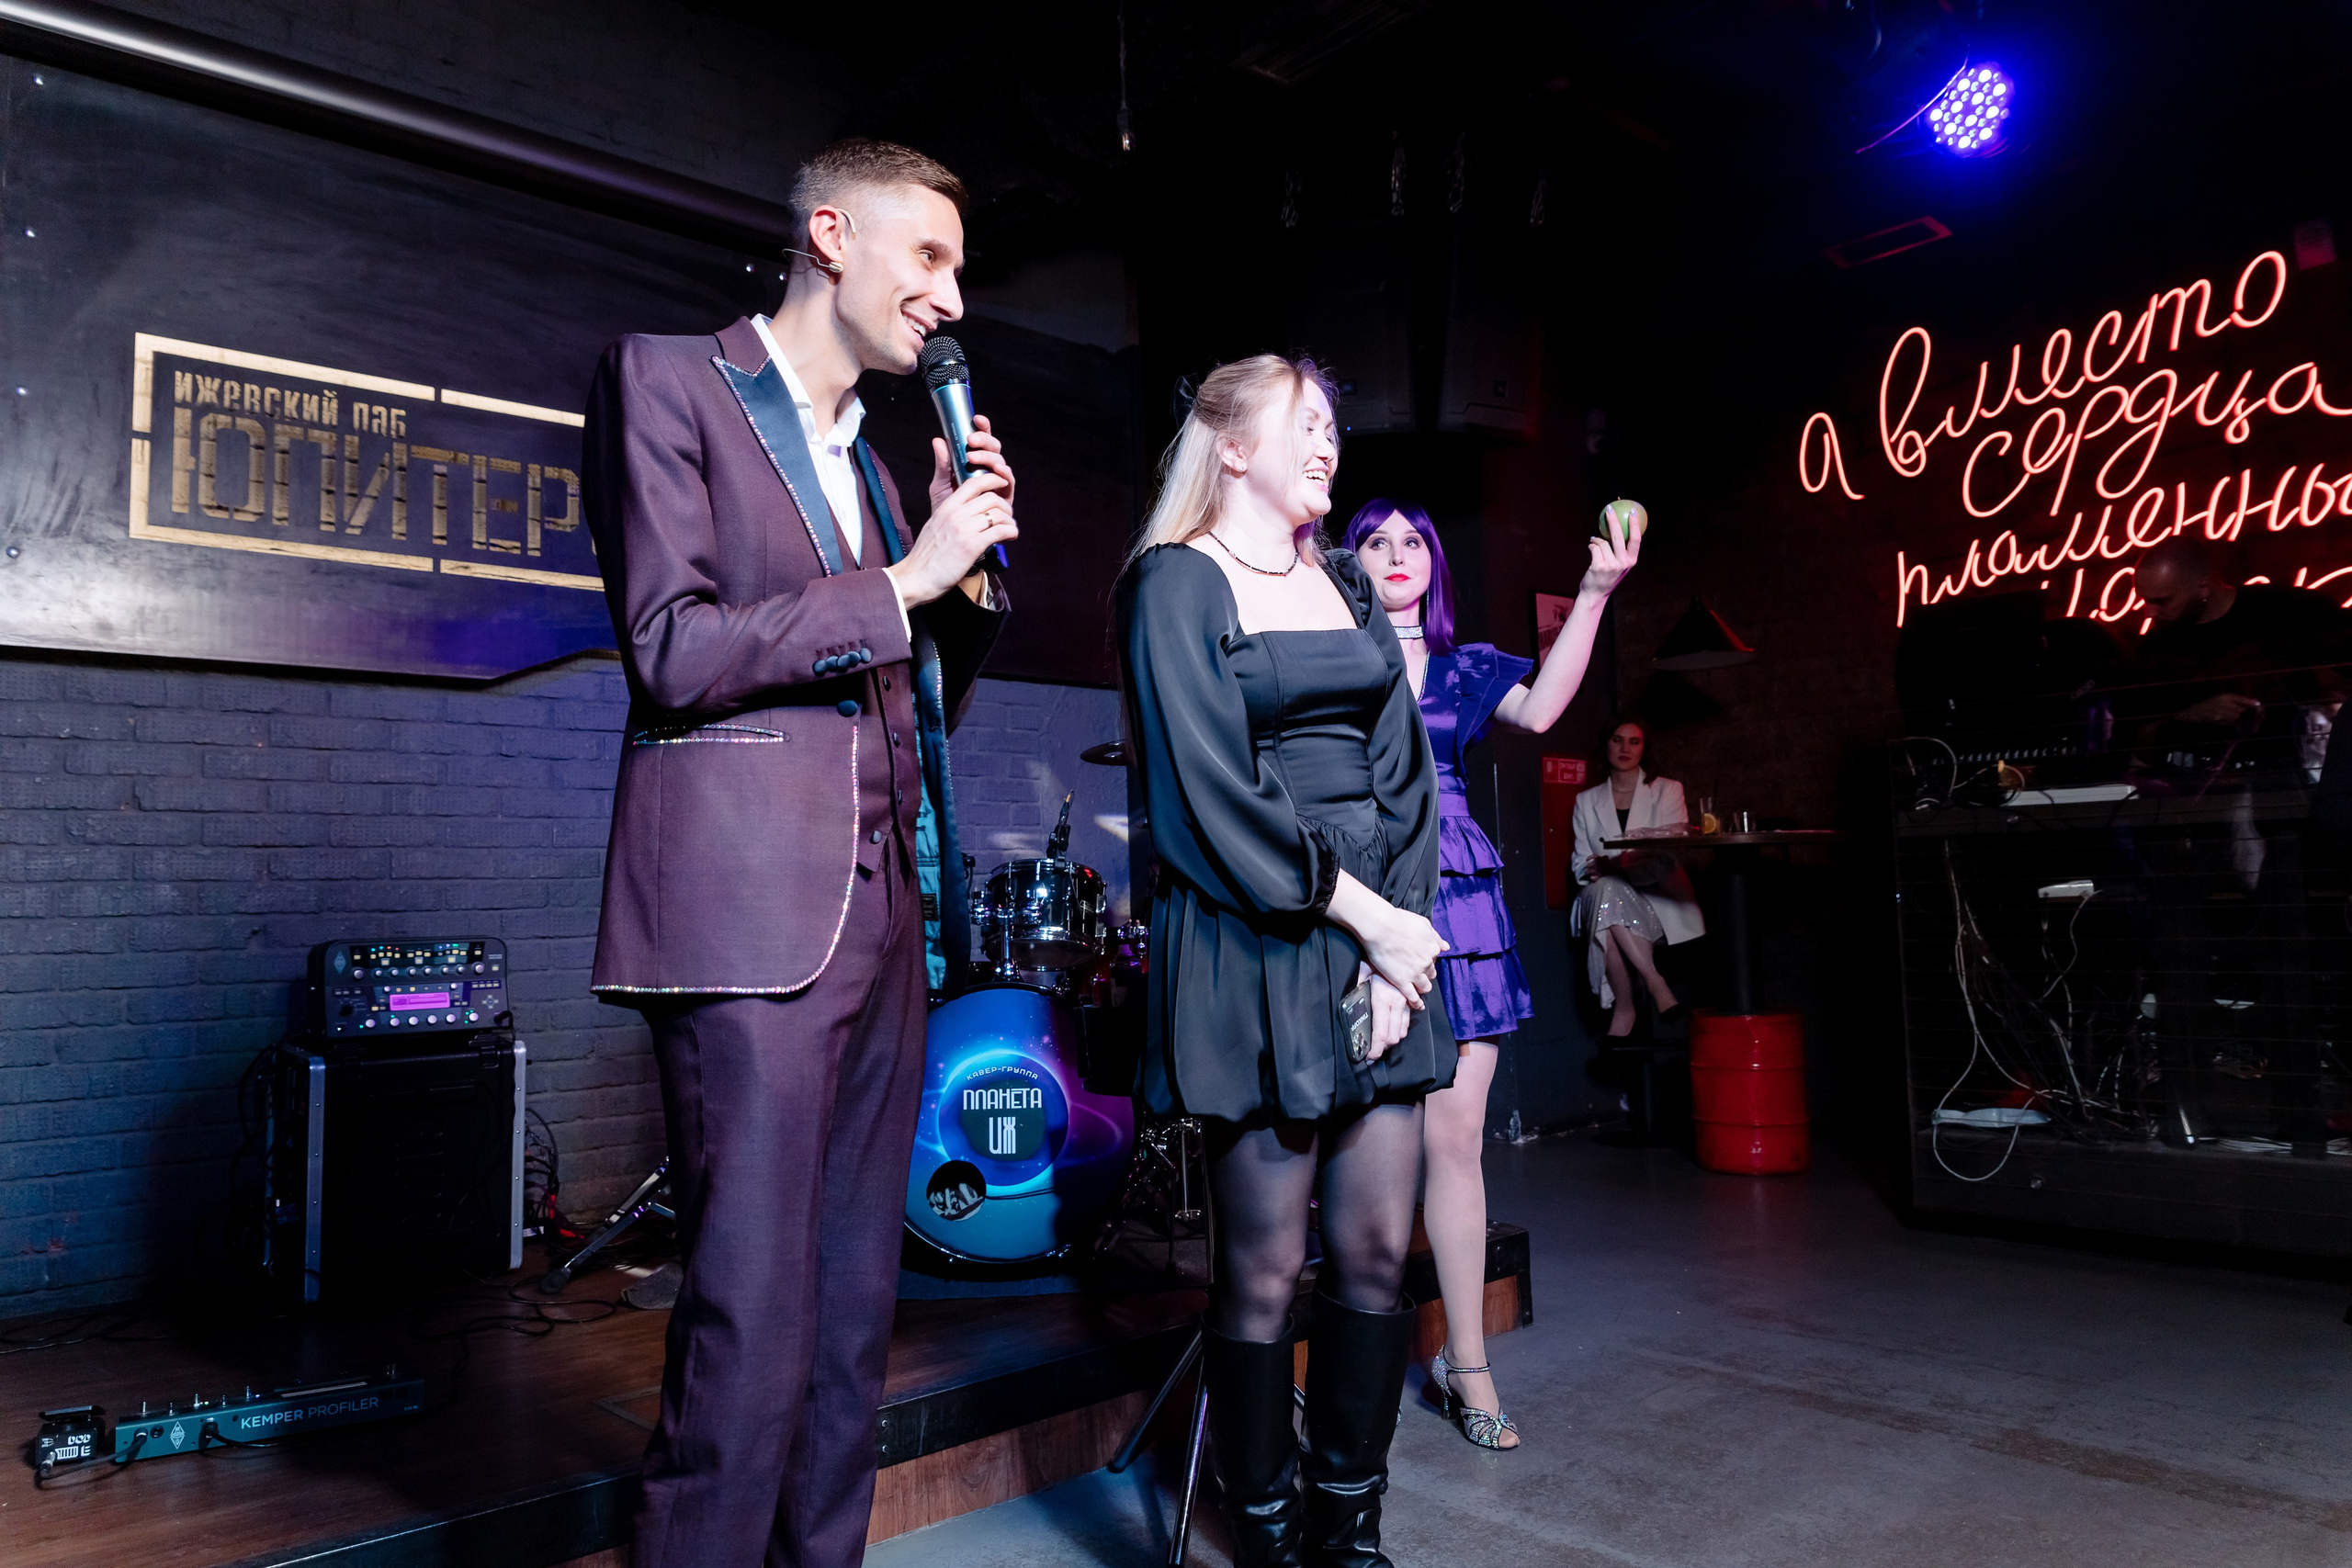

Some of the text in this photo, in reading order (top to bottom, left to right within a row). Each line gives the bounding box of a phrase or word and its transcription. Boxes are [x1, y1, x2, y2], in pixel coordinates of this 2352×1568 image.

[174, 370, 408, 438] ИЖЕВСКИЙ ПАБ
[172, 407, 581, 558] ЮПИТЕР
[966, 1066, 1038, 1081] КАВЕР-ГРУППА
[963, 1088, 1042, 1111] ПЛАНЕТА
[989, 1116, 1016, 1155] ИЖ
[241, 1396, 379, 1430] KEMPER PROFILER
